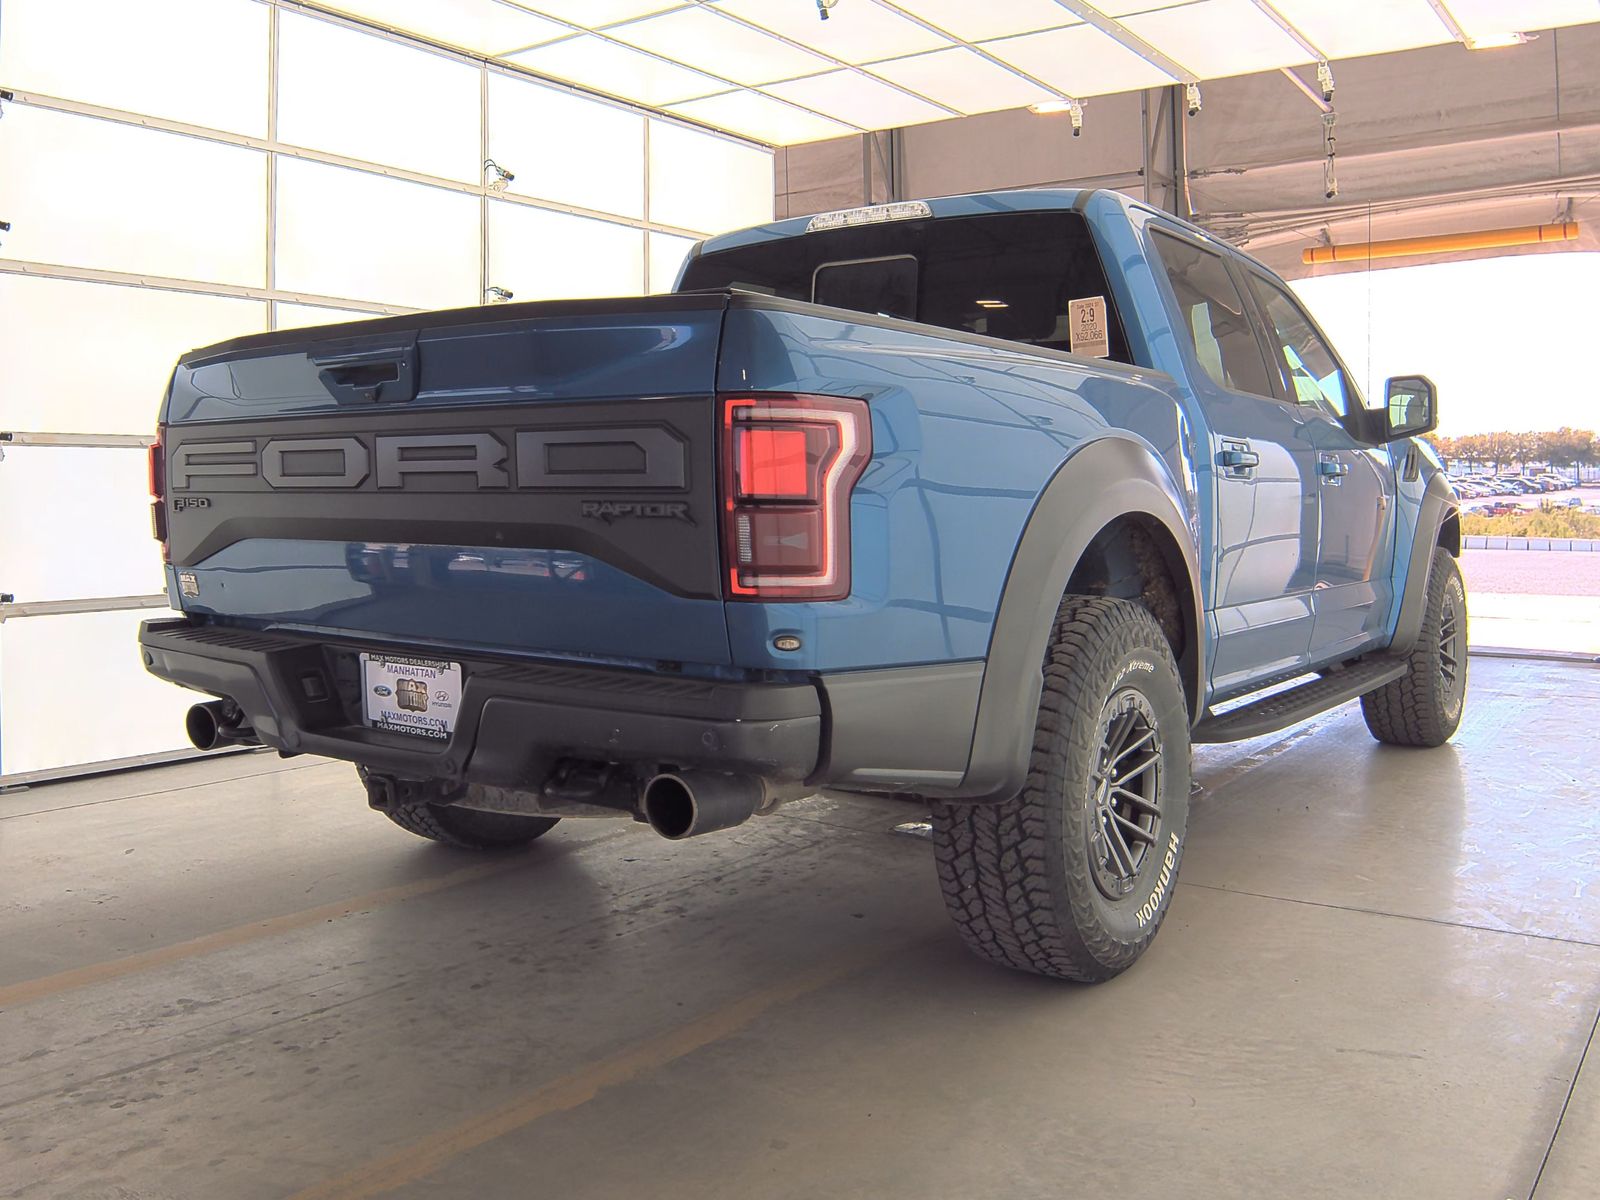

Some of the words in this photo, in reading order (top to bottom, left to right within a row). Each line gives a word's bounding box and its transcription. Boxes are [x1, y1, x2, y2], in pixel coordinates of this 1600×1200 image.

[1081, 322, 1097, 332] 2020
[172, 426, 686, 490] FORD
[581, 501, 698, 527] RAPTOR
[371, 654, 384, 662] MAX
[385, 656, 409, 665] MOTORS
[409, 658, 449, 668] DEALERSHIPS
[386, 664, 436, 679] MANHATTAN
[380, 710, 449, 730] MAXMOTORS.COM
[376, 721, 448, 740] MAXMOTORS.COM
